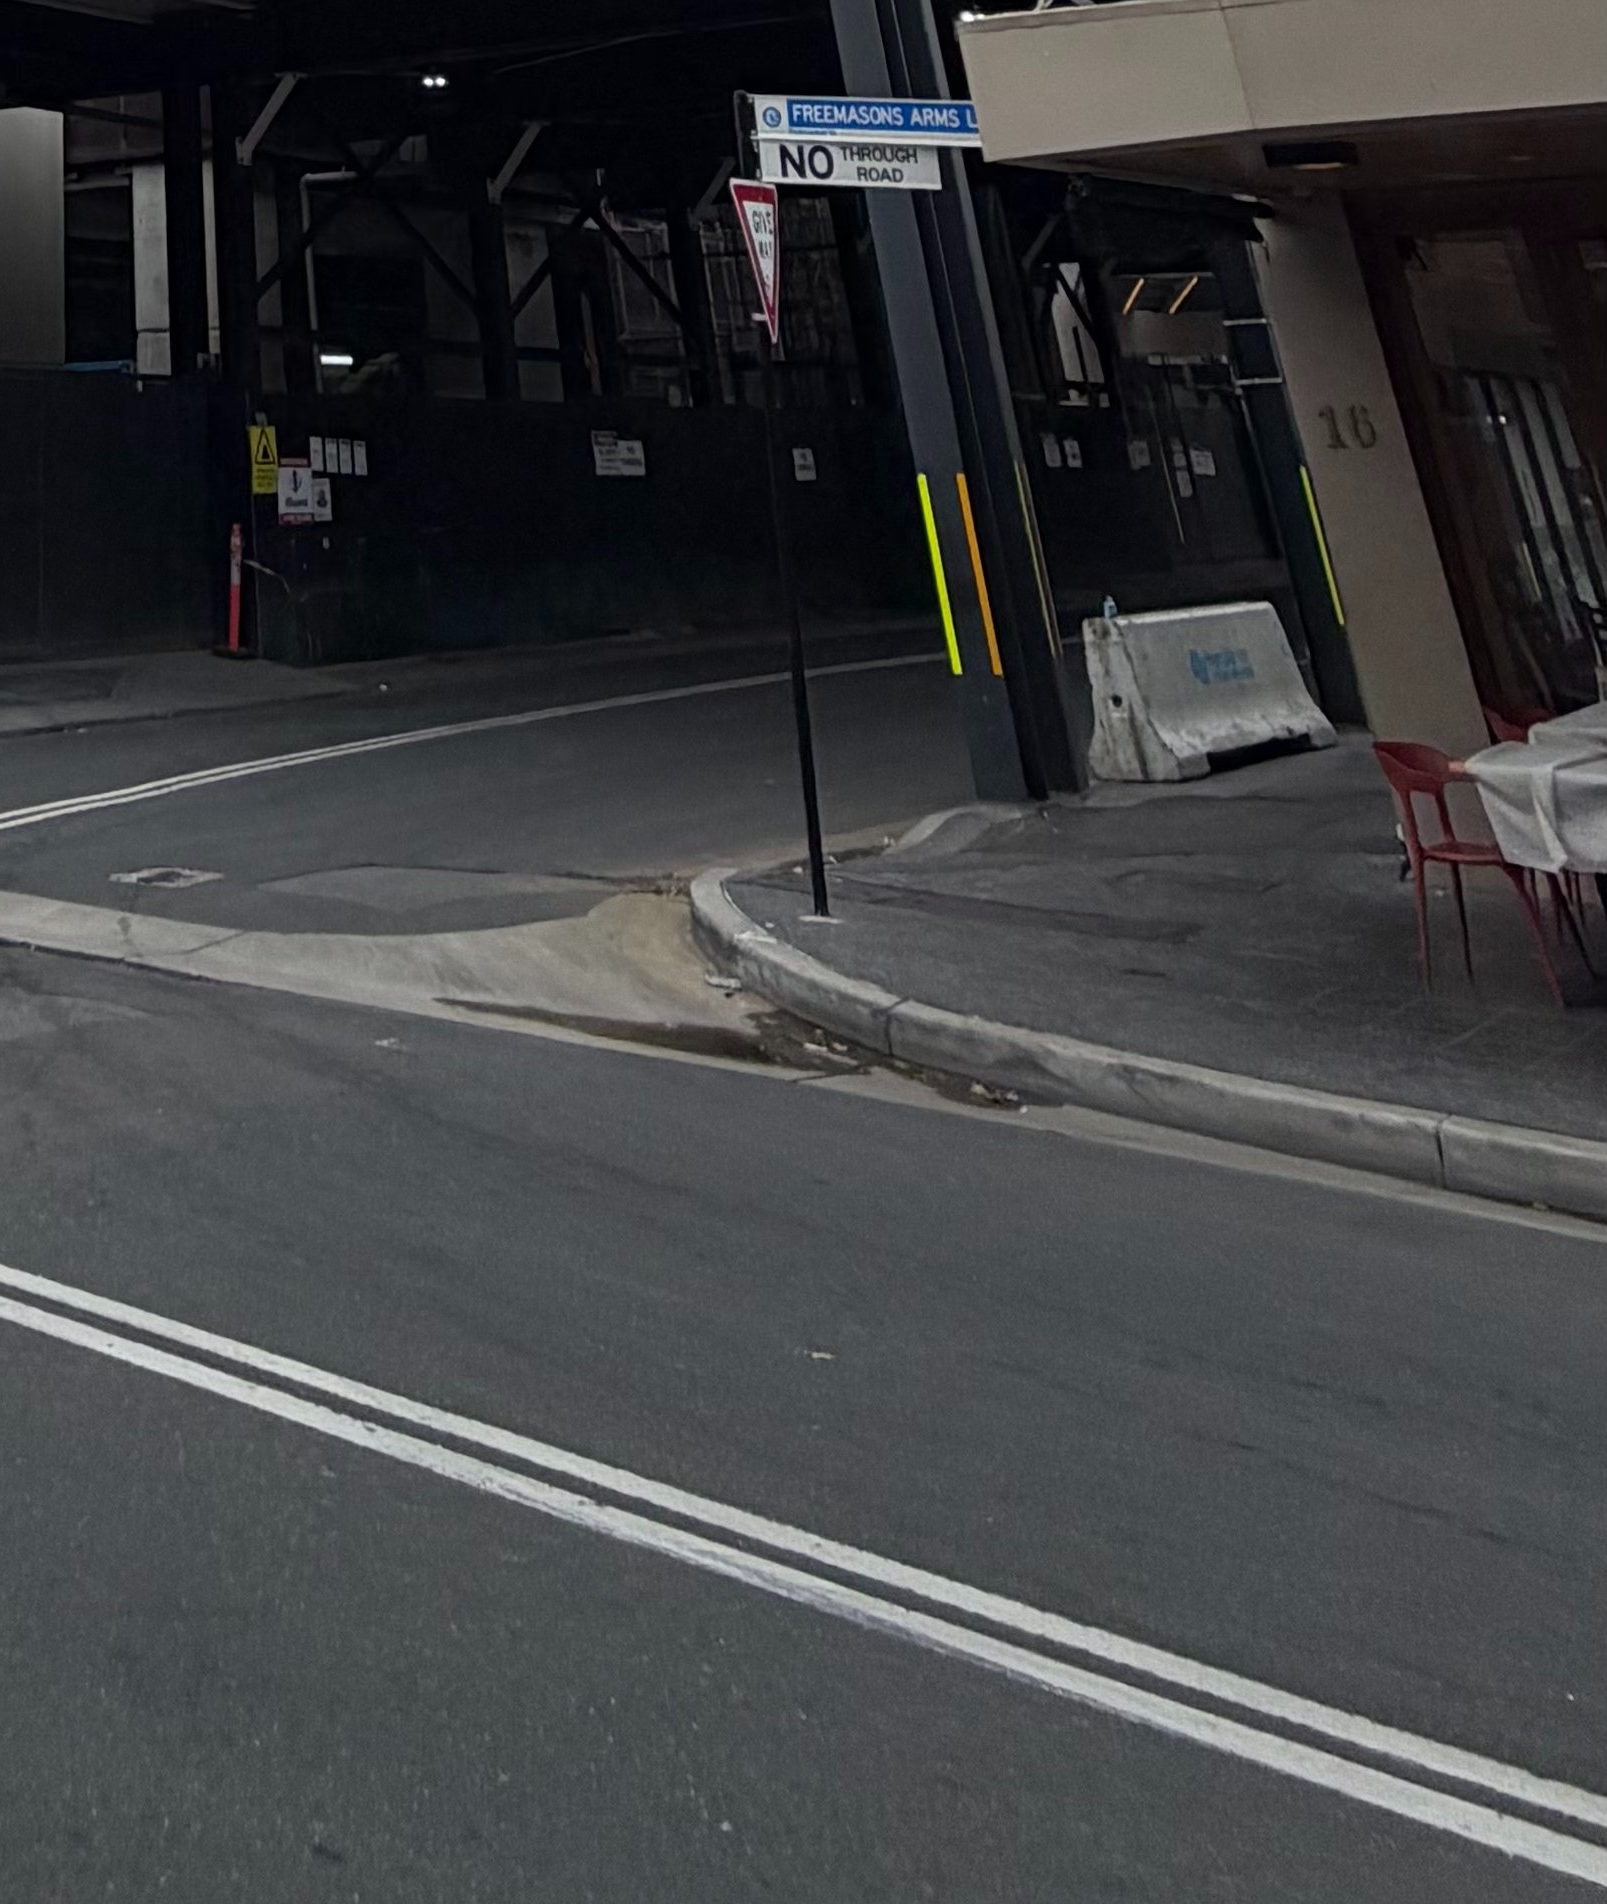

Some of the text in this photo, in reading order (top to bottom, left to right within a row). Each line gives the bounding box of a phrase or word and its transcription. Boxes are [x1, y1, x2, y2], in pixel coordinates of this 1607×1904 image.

[792, 104, 904, 127] FREEMASONS
[910, 108, 961, 128] ARMS
[779, 145, 918, 179] NO THROUGH
[857, 167, 904, 183] ROAD
[752, 210, 774, 234] GIVE
[1318, 404, 1377, 449] 16
